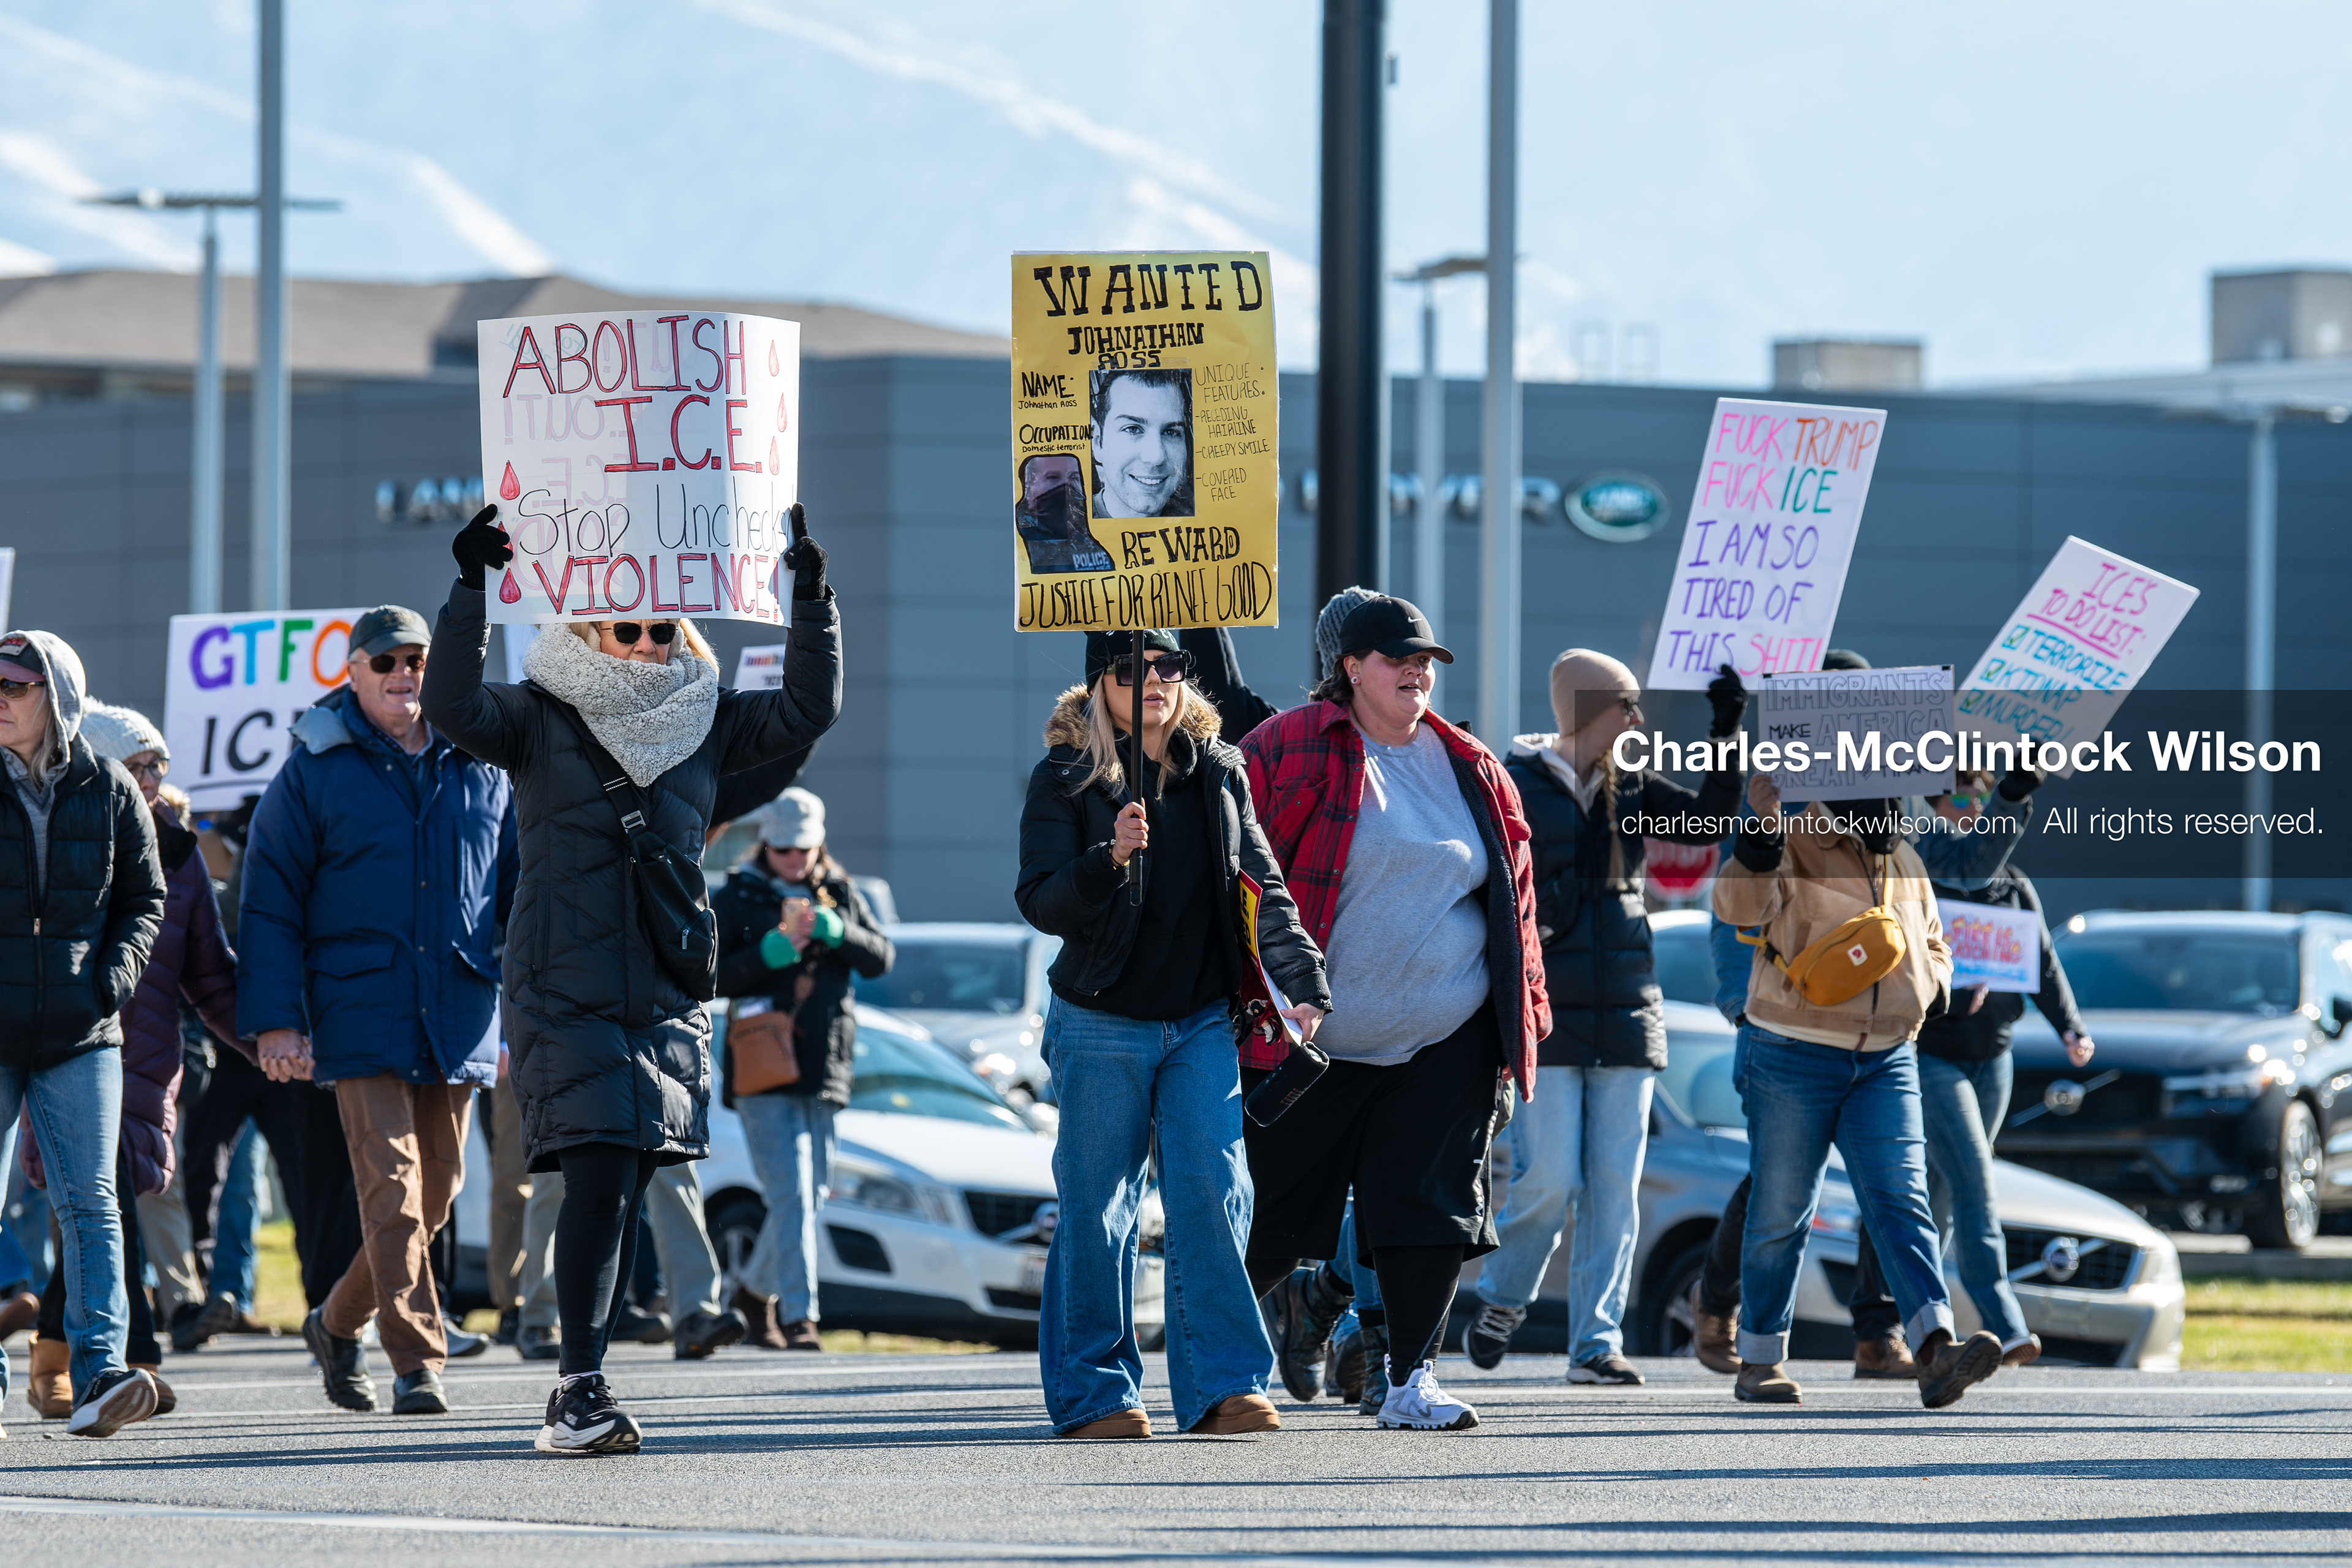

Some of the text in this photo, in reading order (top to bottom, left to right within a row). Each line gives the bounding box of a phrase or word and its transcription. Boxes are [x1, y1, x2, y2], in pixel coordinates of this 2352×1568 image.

[1033, 261, 1262, 317] WANTED
[503, 315, 747, 398] ABOLISH
[1067, 323, 1205, 355] JOHNATHAN
[1098, 350, 1162, 371] ROSS
[1195, 363, 1250, 386] UNIQUE
[595, 394, 763, 473] I.C.E.
[1022, 442, 1086, 453] Domestic terrorist
[1208, 419, 1257, 438] HAIRLINE
[1238, 439, 1270, 455] SMILE
[1716, 412, 1879, 471] FUCK TRUMP
[1211, 486, 1237, 502] FACE
[1703, 461, 1776, 513] FUCK
[1780, 466, 1839, 513] ICE
[518, 488, 630, 557] Stop
[1687, 519, 1820, 570] I AM SO
[1072, 551, 1109, 570] POLICE
[1121, 526, 1240, 569] REWARD
[532, 552, 780, 622] VIOLENCE!
[1019, 561, 1272, 628] JUSTICE FOR RENEE GOOD
[1682, 577, 1814, 625] TIRED OF
[2040, 588, 2069, 616] TO
[2065, 598, 2097, 628] DO
[189, 617, 352, 691] GTFO
[1668, 630, 1736, 676] THIS
[2024, 629, 2128, 695] TERRORIZE
[1765, 672, 1947, 711] IMMIGRANTS
[1996, 662, 2082, 713] KIDNAP
[200, 710, 306, 777] IC
[1769, 708, 1948, 745] MAKE AMERICA
